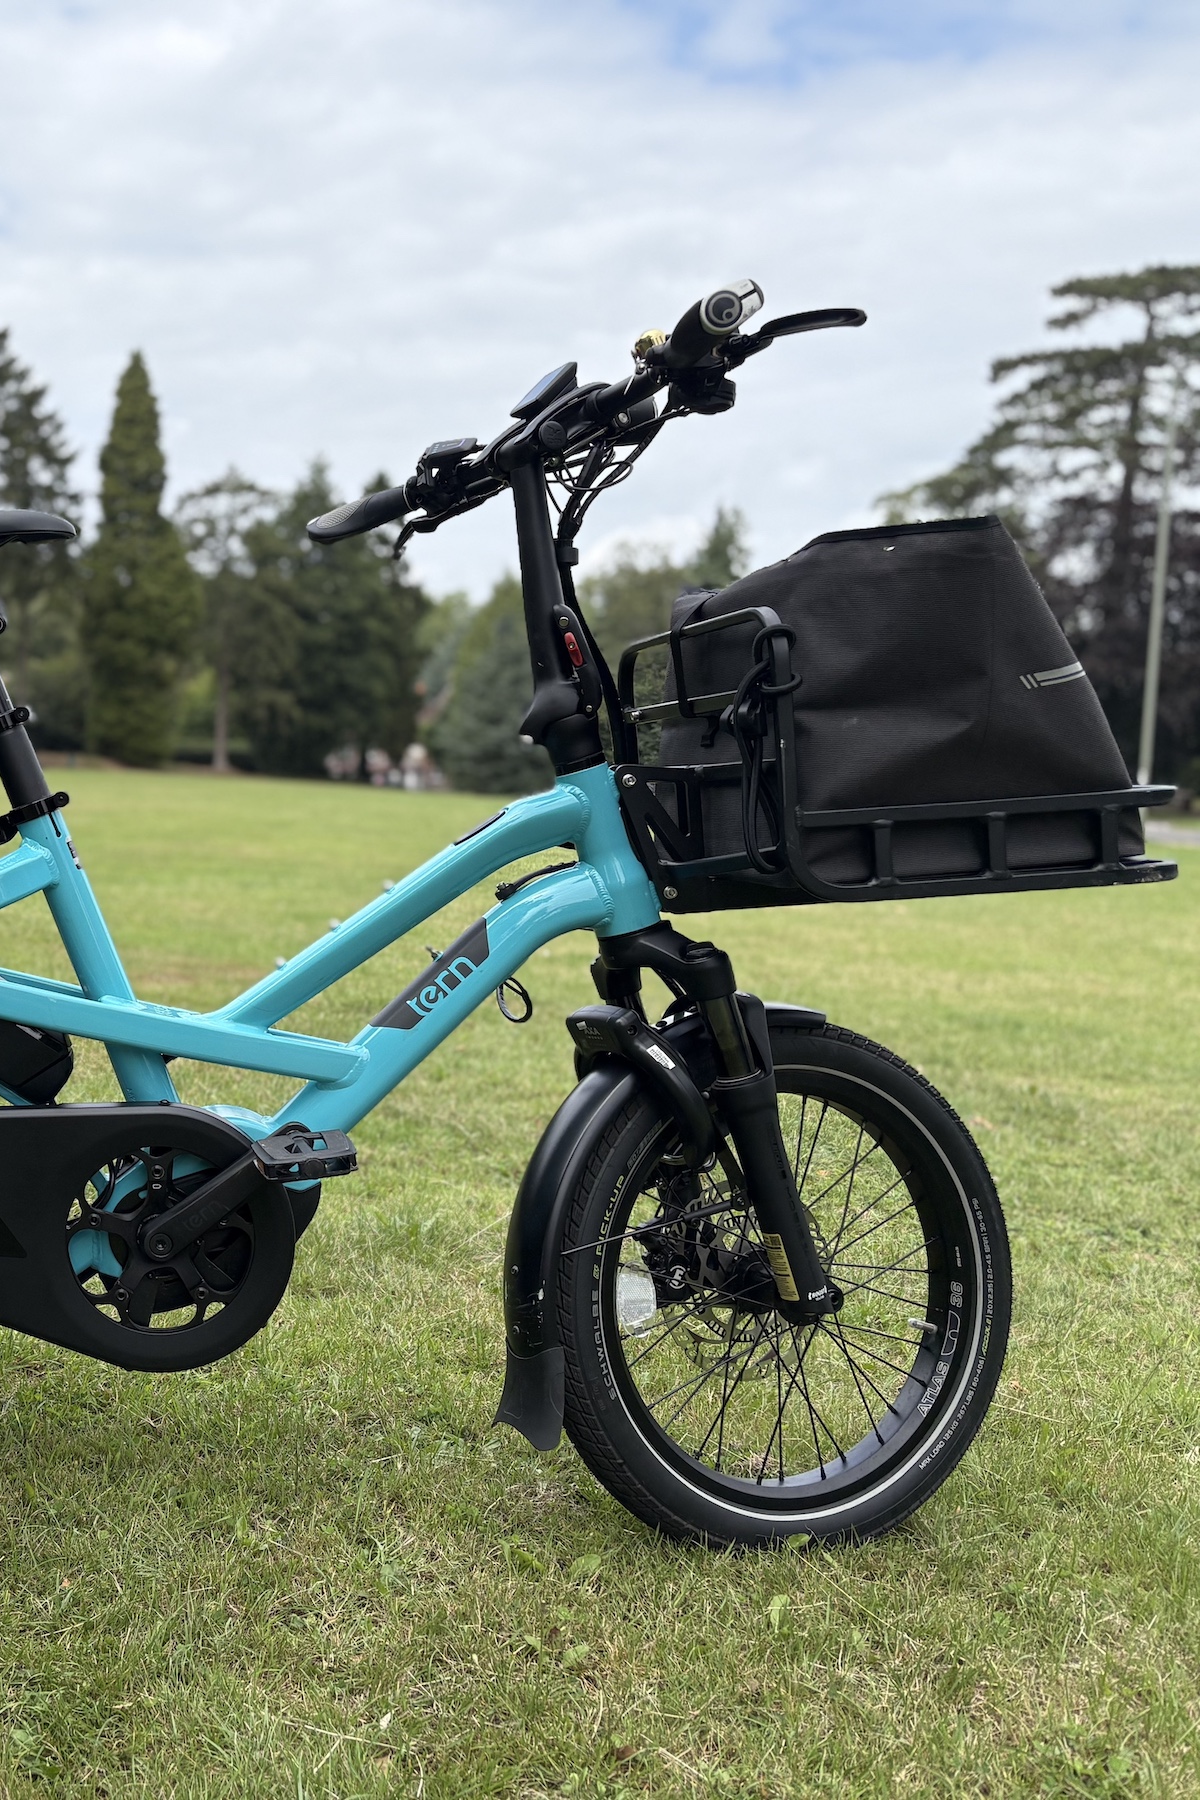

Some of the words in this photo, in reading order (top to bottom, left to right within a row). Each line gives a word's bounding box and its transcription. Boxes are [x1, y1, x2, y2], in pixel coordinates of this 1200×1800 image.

[406, 956, 478, 1016] tern
[595, 1175, 625, 1256] PICK-UP
[591, 1289, 618, 1400] SCHWALBE
[917, 1361, 949, 1417] ATLAS
[949, 1280, 963, 1308] 36
[930, 1440, 946, 1458] LOAD
[943, 1430, 953, 1442] 125
[951, 1421, 959, 1433] KG
[972, 1359, 986, 1388] 60-406
